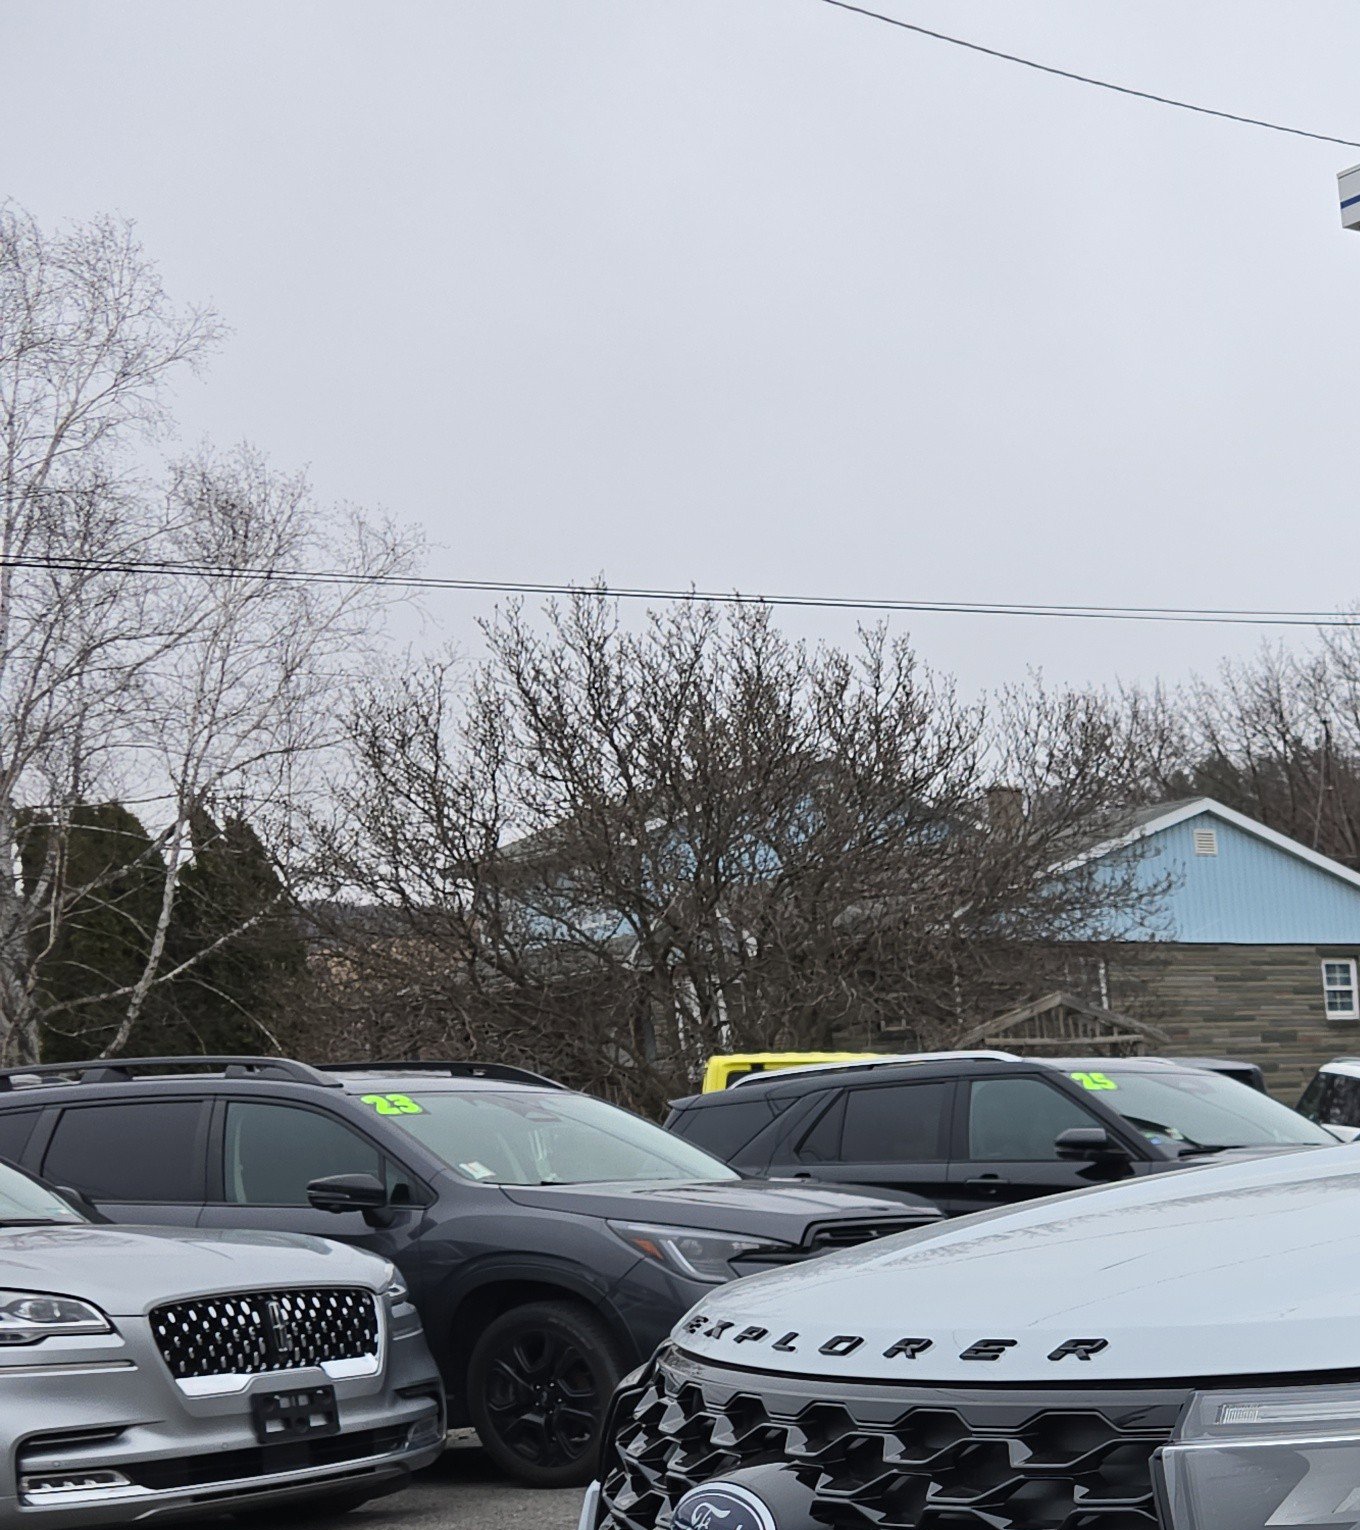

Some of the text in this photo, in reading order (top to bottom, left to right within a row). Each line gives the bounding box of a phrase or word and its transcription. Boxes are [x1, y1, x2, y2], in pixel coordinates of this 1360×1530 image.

[1071, 1072, 1118, 1090] 25
[361, 1094, 423, 1115] 23
[682, 1315, 1110, 1362] EXPLORER
